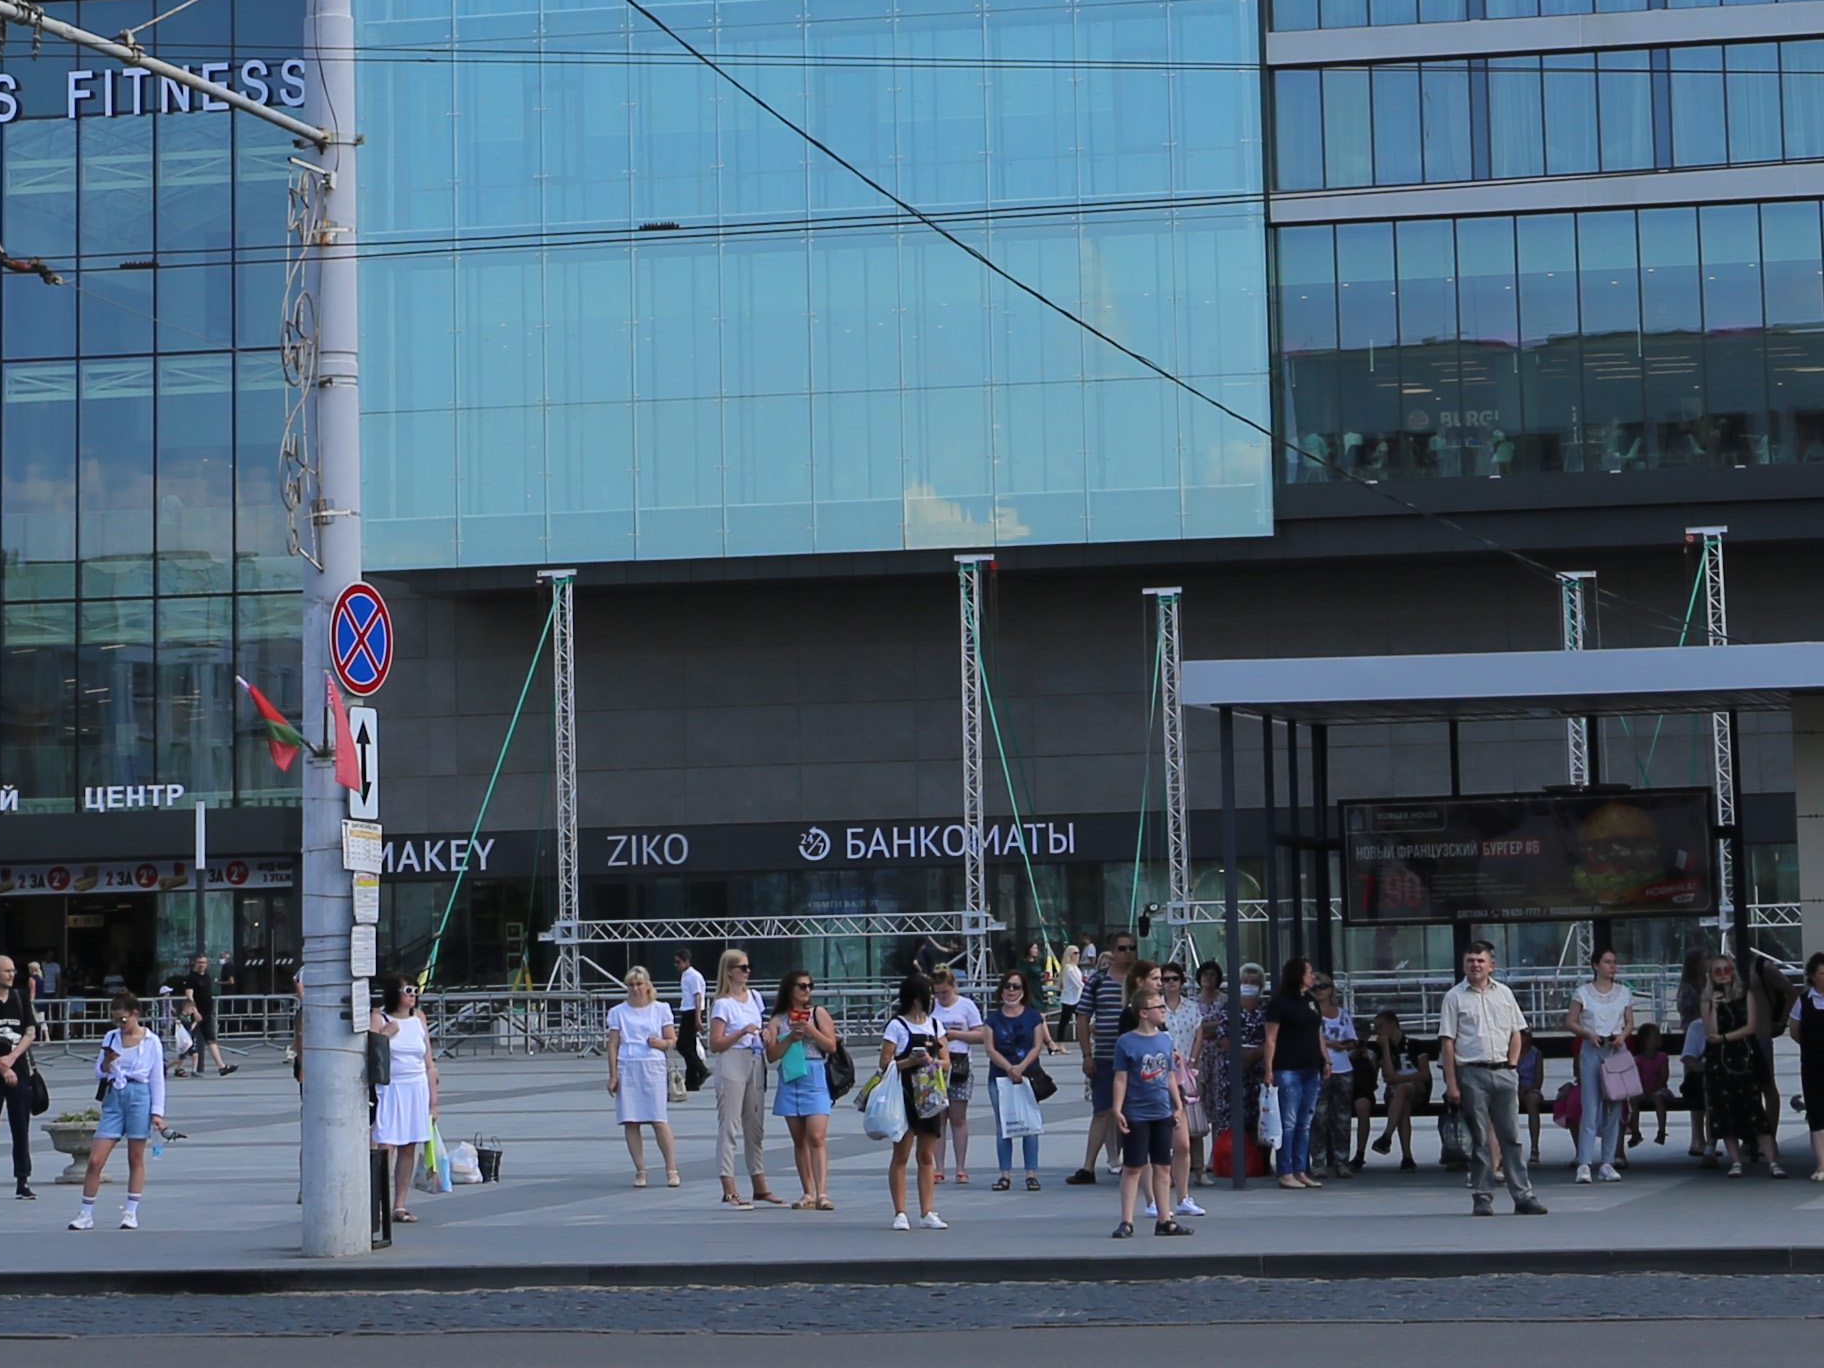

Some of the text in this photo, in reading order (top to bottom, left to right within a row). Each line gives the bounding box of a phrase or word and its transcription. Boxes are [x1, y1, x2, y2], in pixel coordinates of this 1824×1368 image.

[67, 58, 306, 119] FITNESS
[84, 784, 185, 813] ЦЕНТР
[607, 833, 689, 867] ZIKO
[845, 821, 1076, 860] БАНКОМАТЫ
[1355, 839, 1541, 860] НОВЫЙ ФРАНЦУЗСКИЙ БУРГЕР #6
[1358, 872, 1422, 908] 7.90
[1644, 881, 1697, 897] НОВИНКА!
